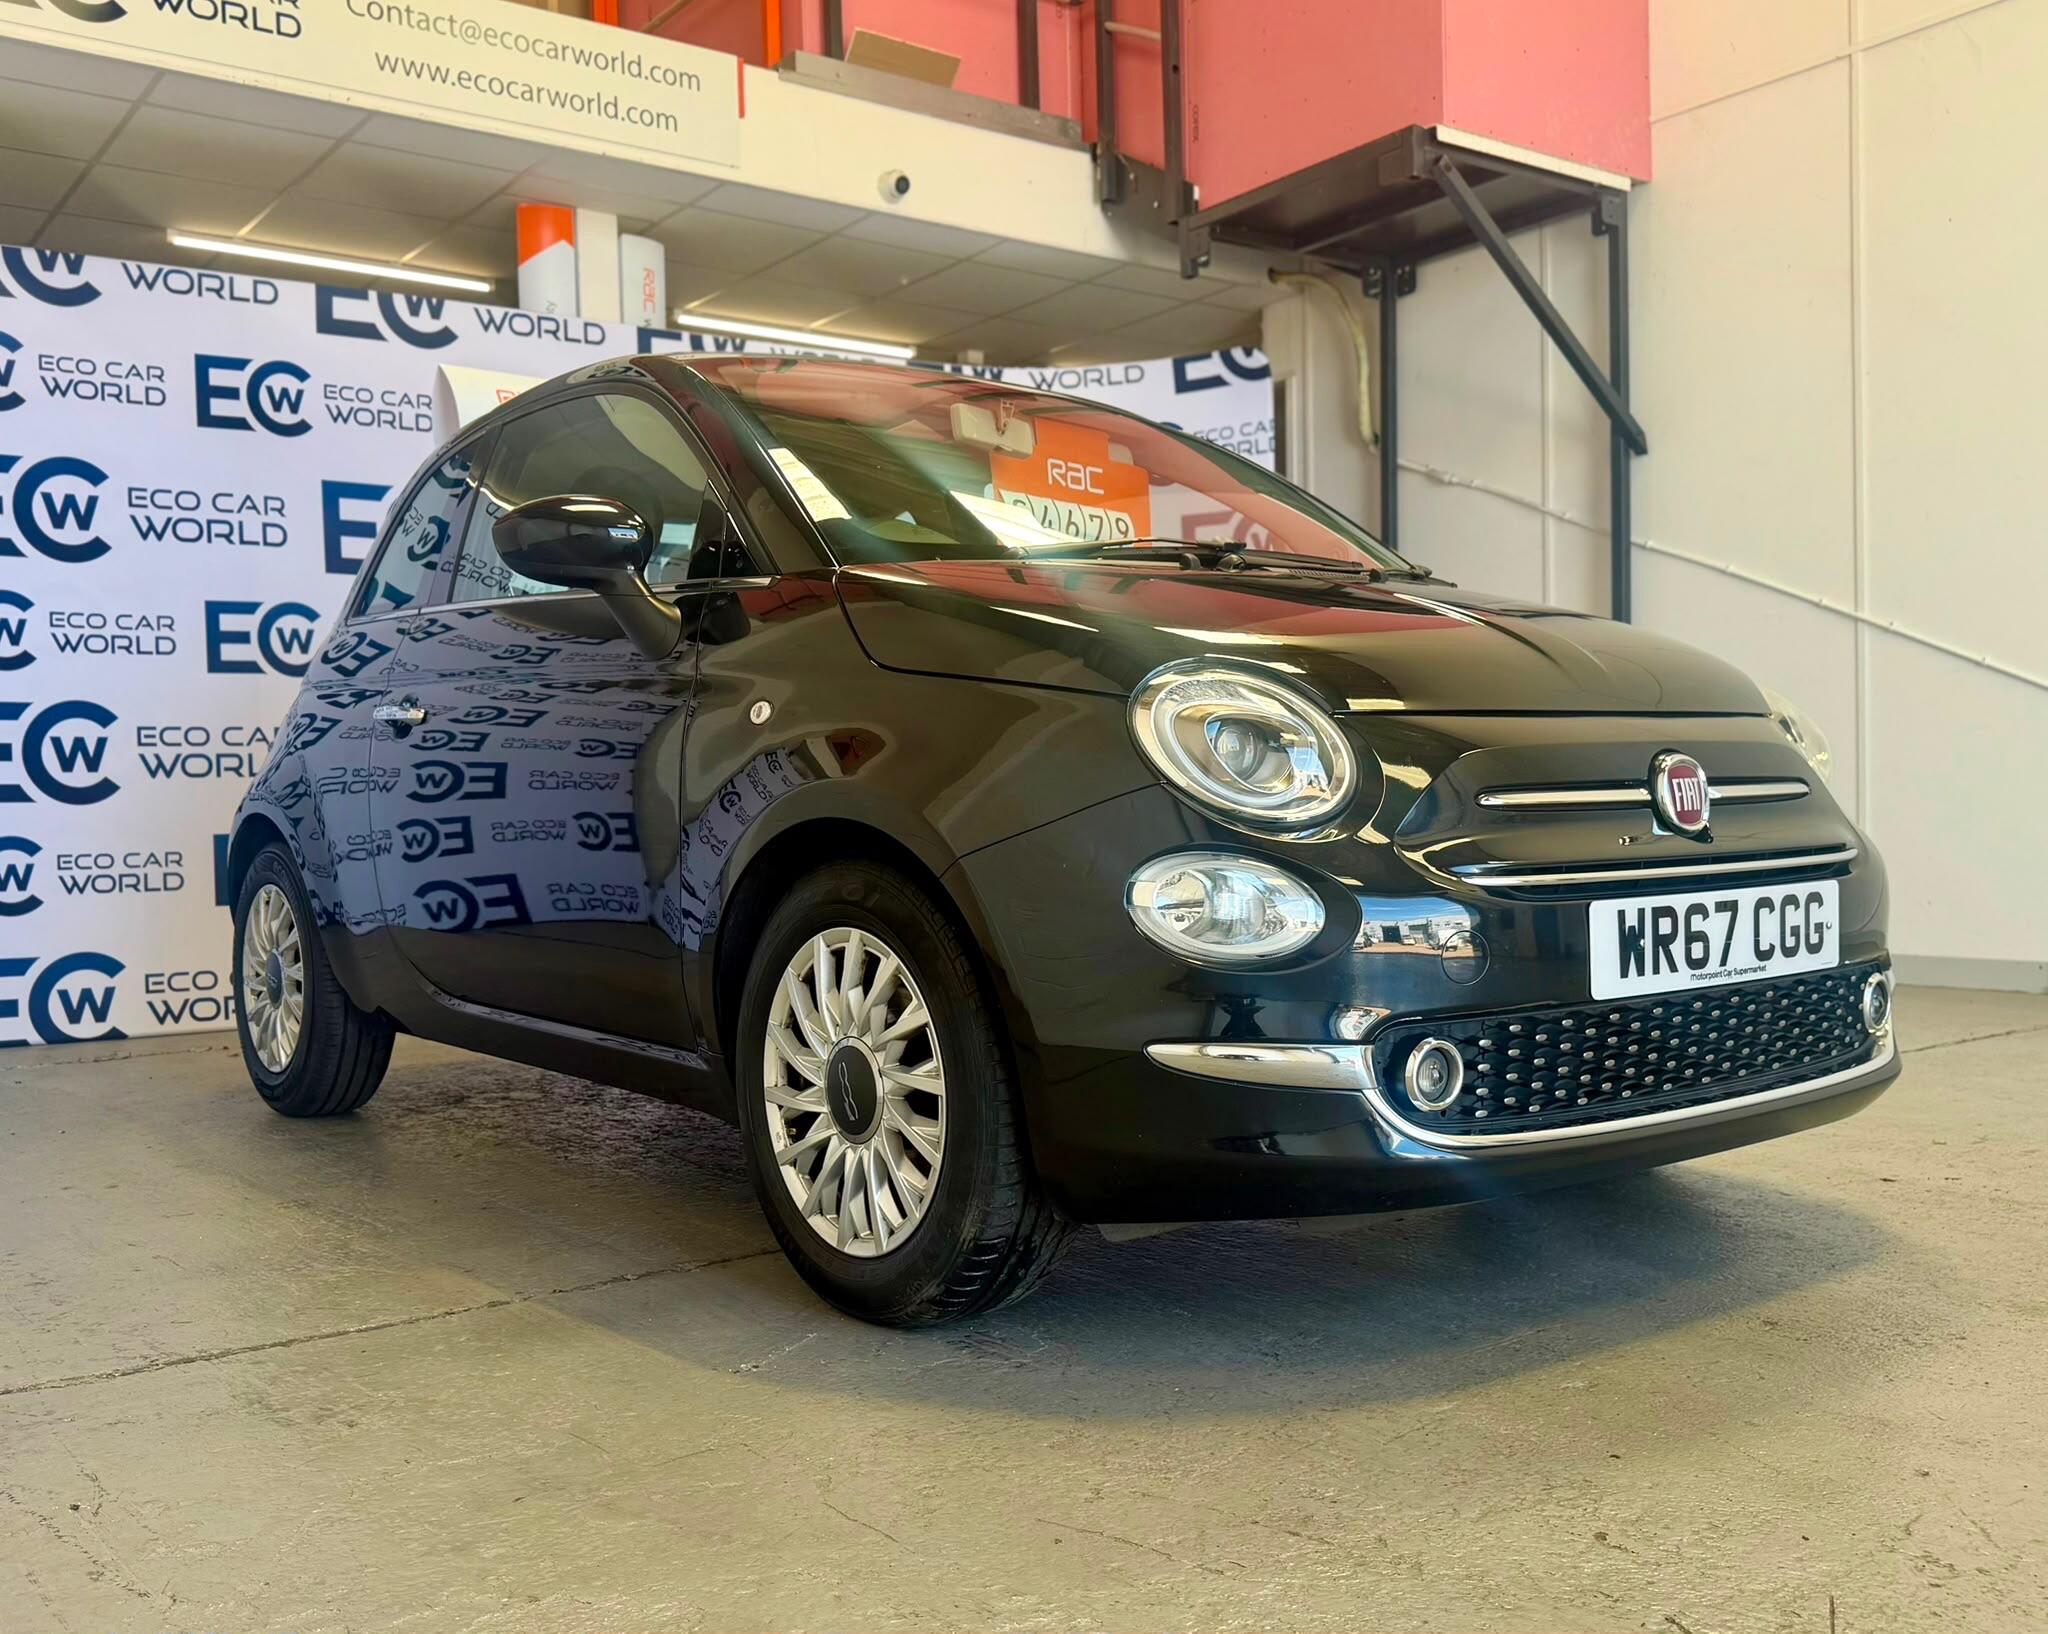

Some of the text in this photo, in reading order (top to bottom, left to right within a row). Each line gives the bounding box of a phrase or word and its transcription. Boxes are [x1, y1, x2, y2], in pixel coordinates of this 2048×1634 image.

[346, 0, 701, 92] Contact@ecocarworld.com
[374, 51, 679, 133] www.ecocarworld.com
[121, 262, 279, 305] WORLD
[474, 307, 606, 345] WORLD
[38, 354, 166, 382] ECO CAR
[1028, 364, 1145, 391] WORLD
[40, 376, 167, 406] WORLD
[323, 383, 432, 410] ECO CAR
[325, 404, 432, 433] WORLD
[127, 487, 286, 518] ECO CAR
[129, 514, 288, 547] WORLD
[49, 611, 175, 632] ECO CAR
[50, 632, 177, 656] WORLD
[137, 726, 210, 747] ECO
[221, 726, 279, 747] CA
[138, 753, 262, 779] WORL
[1671, 777, 1702, 812] FIAT
[57, 851, 183, 871] ECO CAR
[58, 872, 185, 895] WORLD
[1617, 891, 1825, 979] WR67 CGG
[144, 970, 218, 994] ECO
[1723, 967, 1734, 978] Car
[1733, 964, 1767, 977] Supermarket
